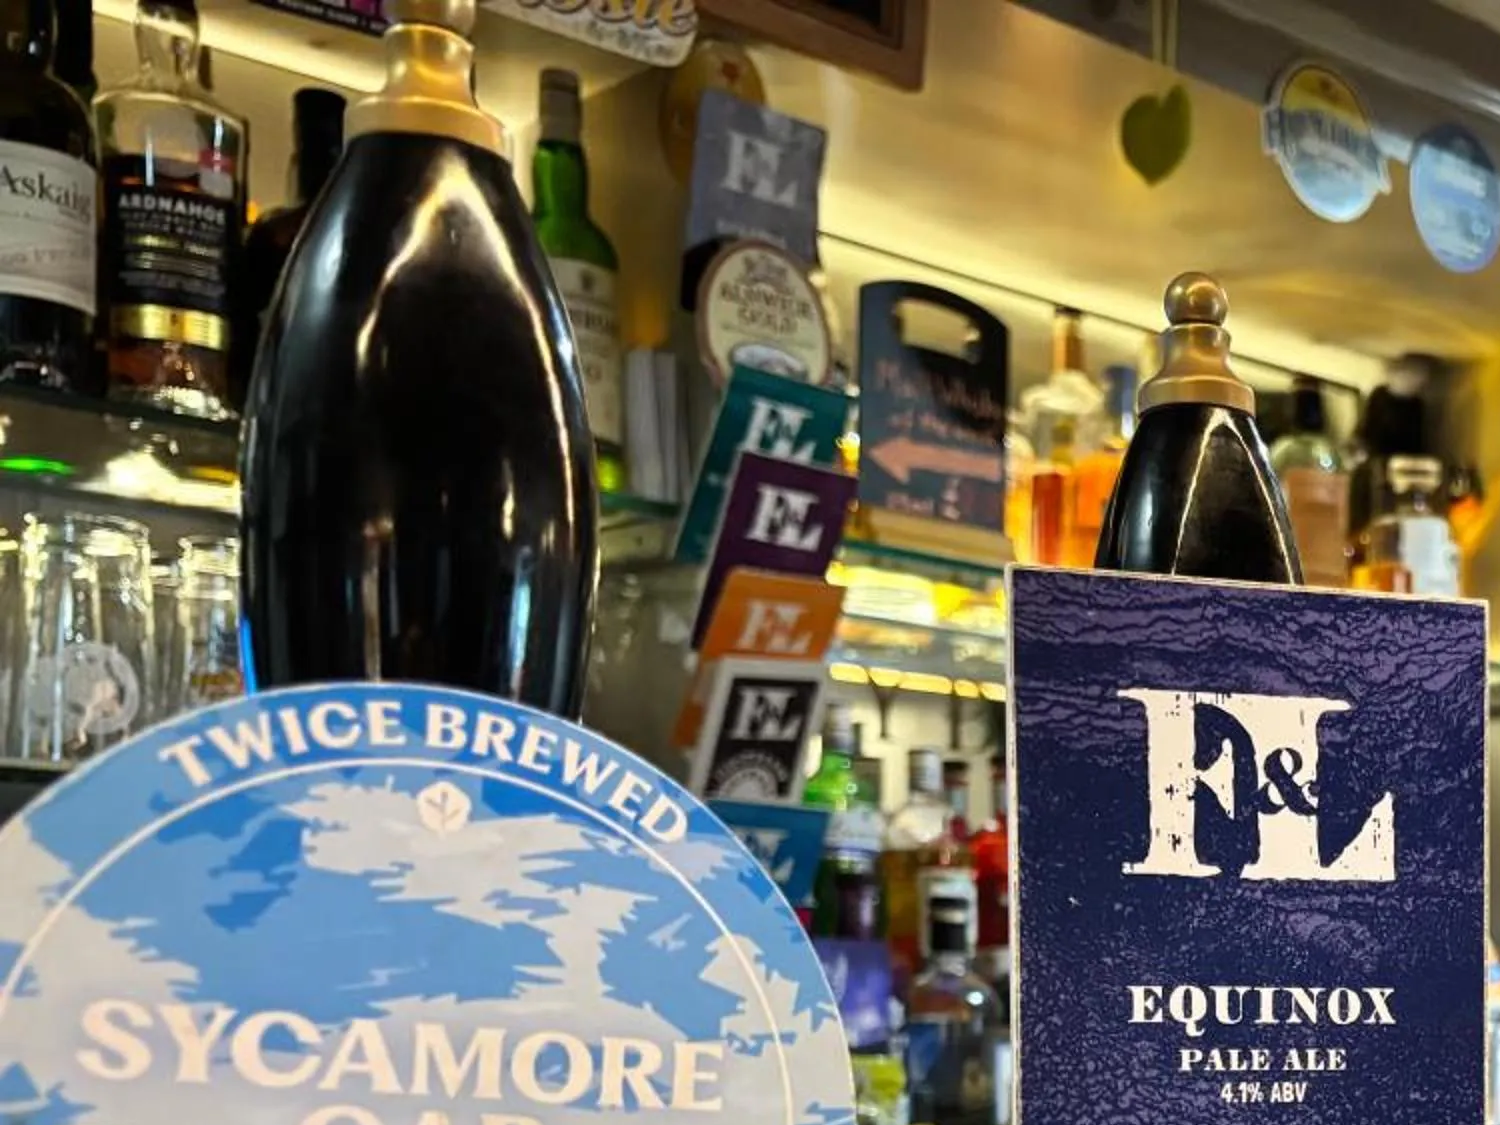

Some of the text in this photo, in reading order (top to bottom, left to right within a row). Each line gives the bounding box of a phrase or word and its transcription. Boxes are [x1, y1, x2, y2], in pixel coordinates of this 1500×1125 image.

[158, 700, 406, 787] TWICE
[425, 703, 689, 844] BREWED
[1127, 985, 1396, 1037] EQUINOX
[76, 999, 726, 1112] SYCAMORE
[1179, 1049, 1347, 1071] PALE ALE
[1221, 1082, 1308, 1103] 4.1% ABV
